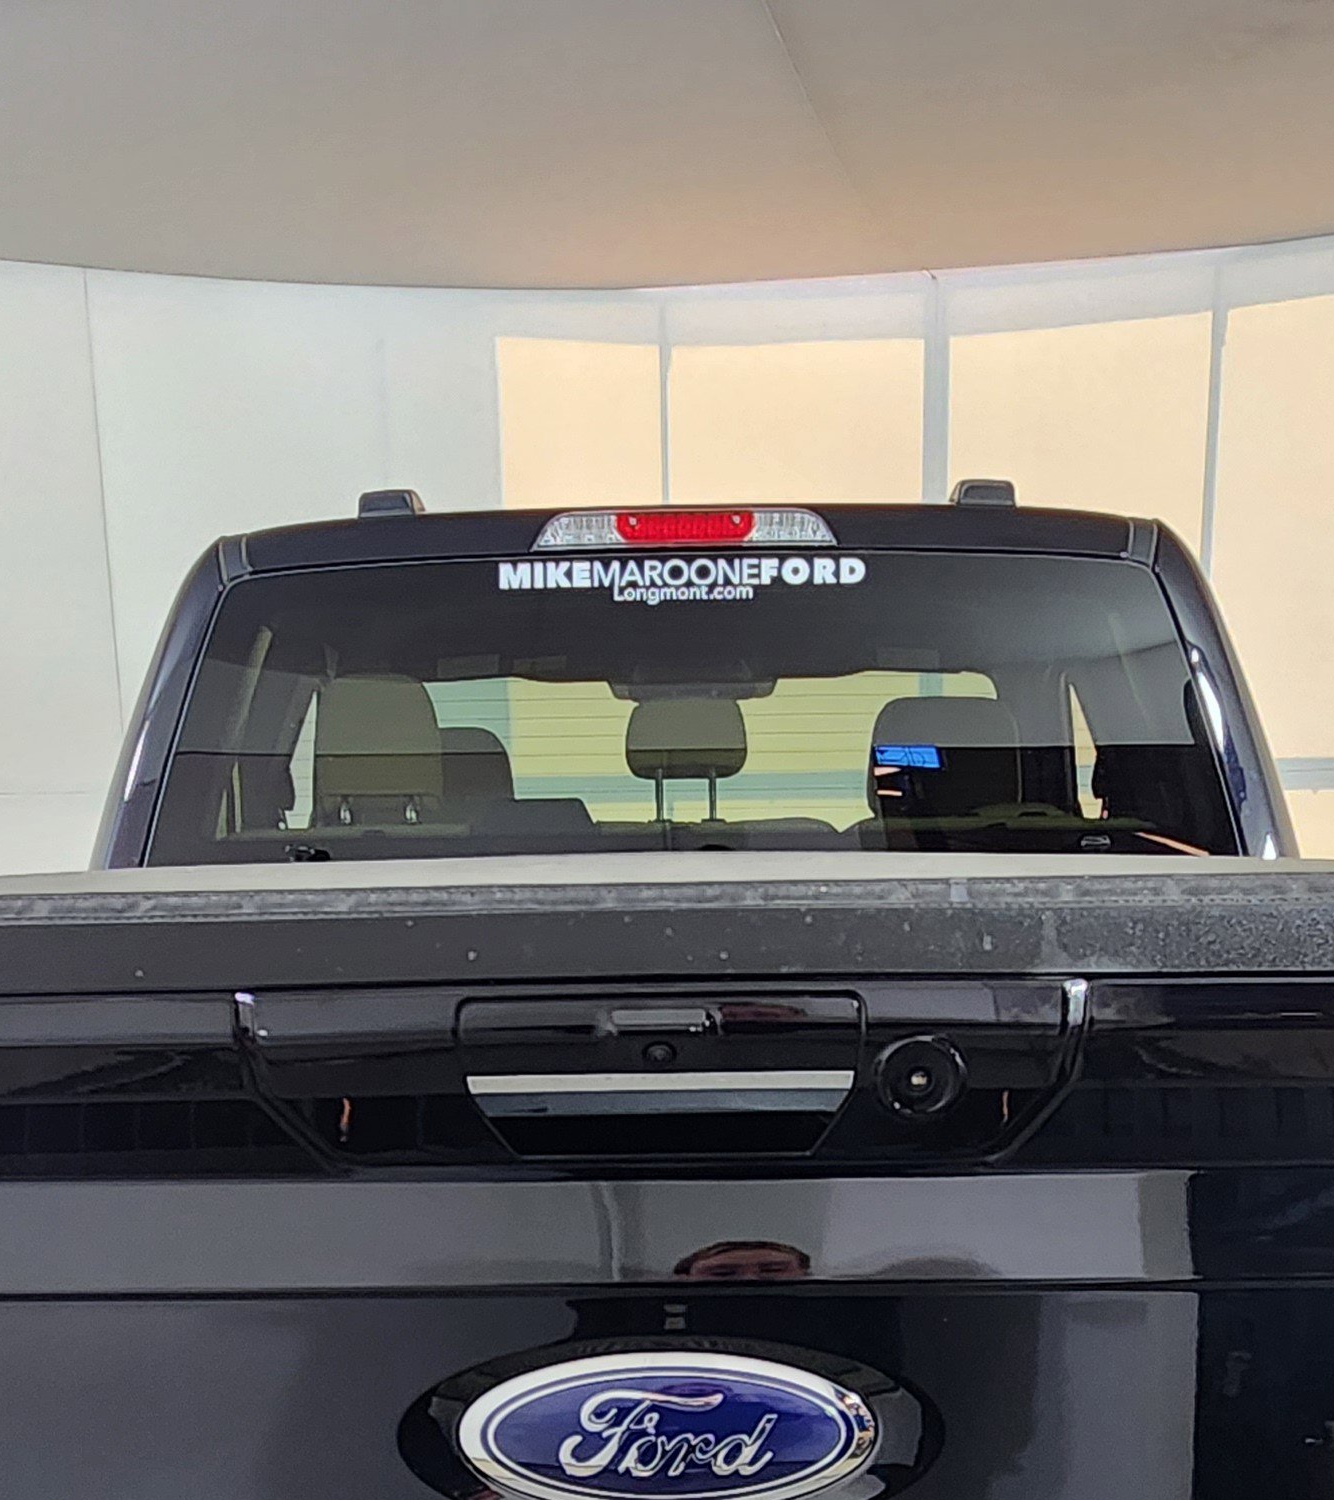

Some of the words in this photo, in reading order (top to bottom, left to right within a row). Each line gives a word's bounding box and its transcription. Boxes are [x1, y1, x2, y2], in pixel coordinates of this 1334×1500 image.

[498, 557, 866, 589] MIKEMAROONEFORD
[613, 584, 754, 605] Longmont.com
[558, 1389, 778, 1478] Ford
